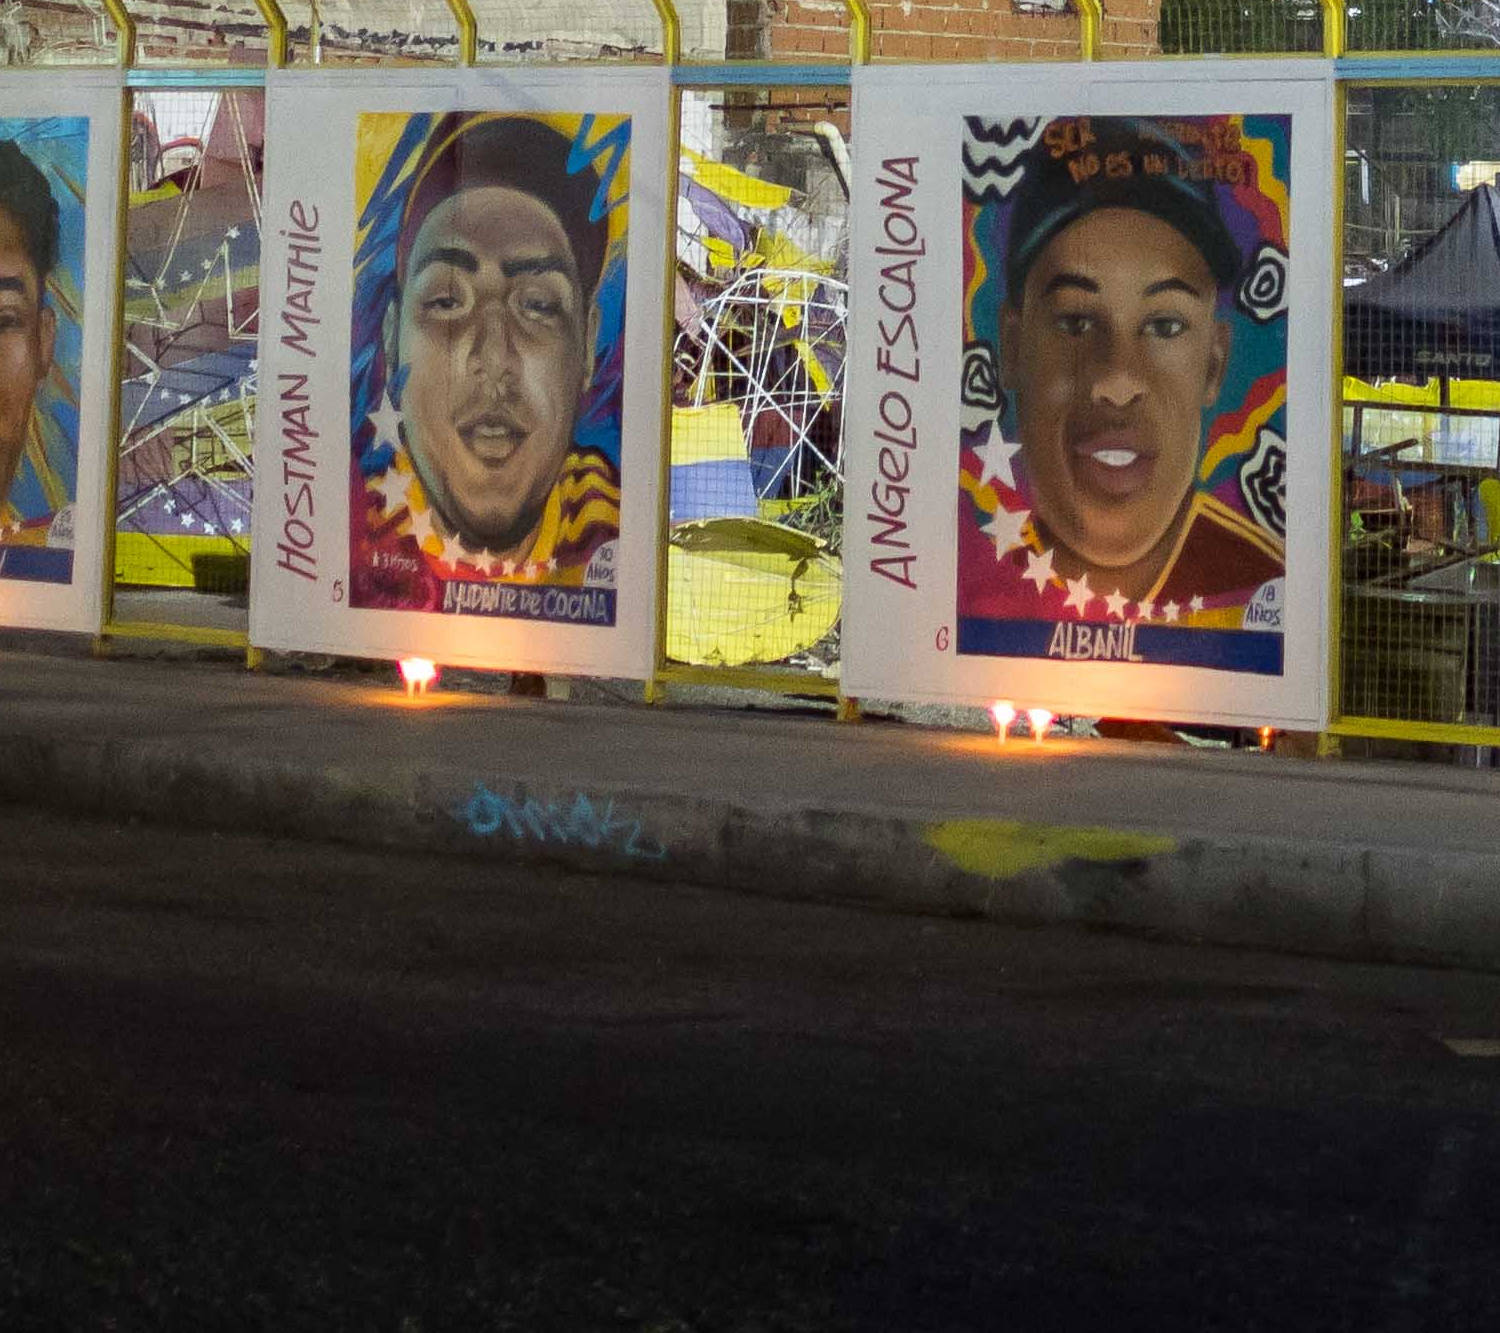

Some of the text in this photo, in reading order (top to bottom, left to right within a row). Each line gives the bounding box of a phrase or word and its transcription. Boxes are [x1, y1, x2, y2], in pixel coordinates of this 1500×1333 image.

[874, 155, 926, 383] ESCALONA
[1414, 350, 1492, 367] SANTO
[276, 373, 320, 582] HOSTMAN
[332, 579, 344, 604] 5
